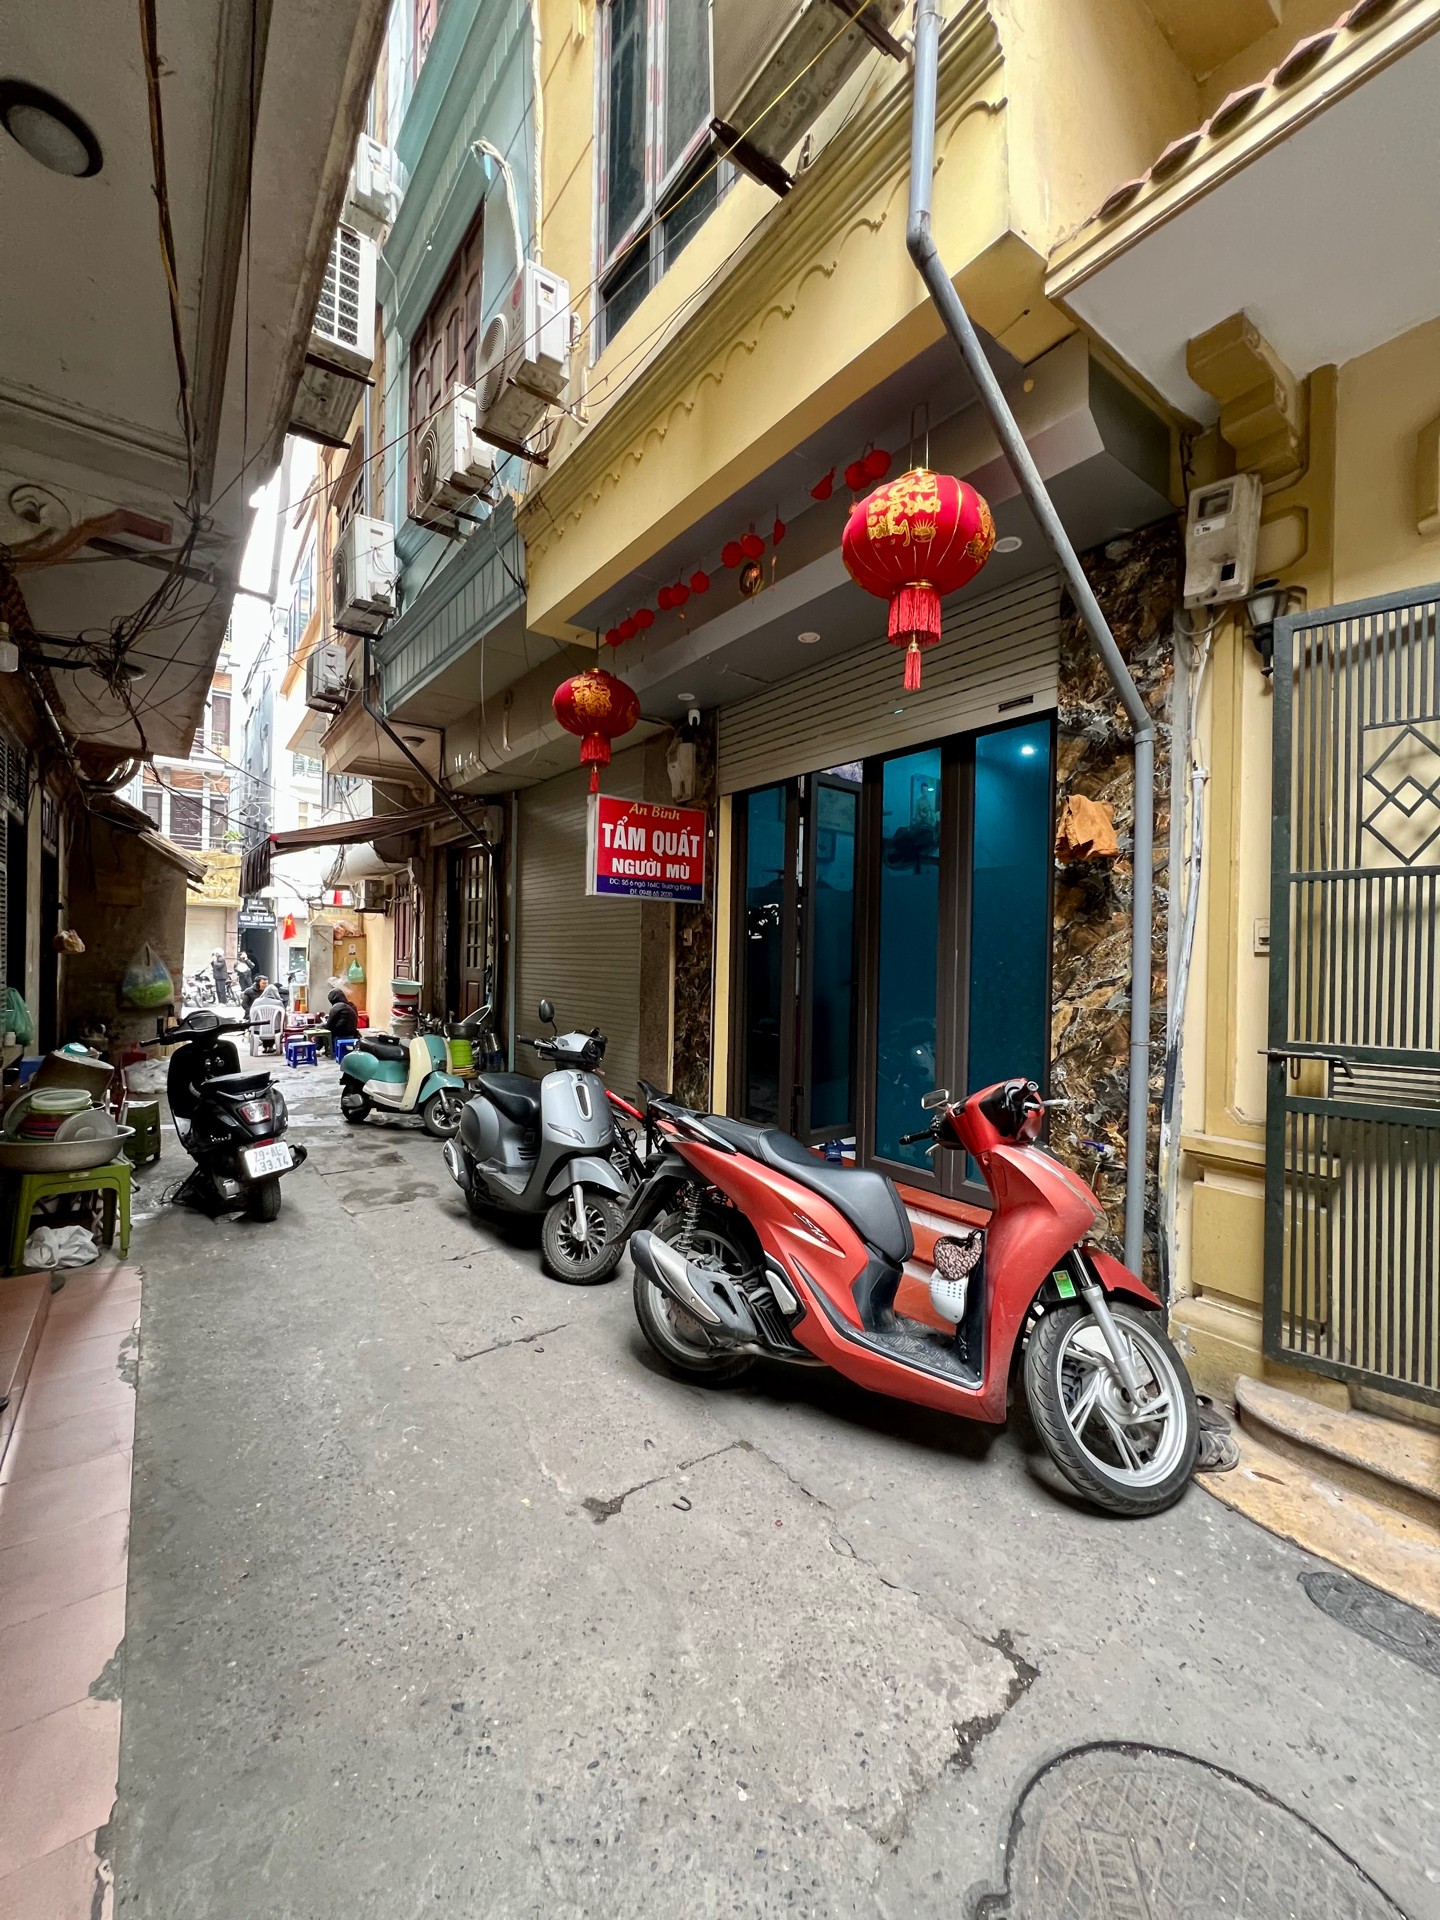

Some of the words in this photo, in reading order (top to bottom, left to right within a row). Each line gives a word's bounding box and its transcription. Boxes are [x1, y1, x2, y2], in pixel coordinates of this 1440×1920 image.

[629, 803, 648, 816] An
[652, 805, 680, 821] Bình
[602, 816, 646, 852] TẨM
[652, 826, 701, 858] QUẤT
[612, 857, 662, 878] NGƯỜI
[666, 862, 690, 880] MÙ
